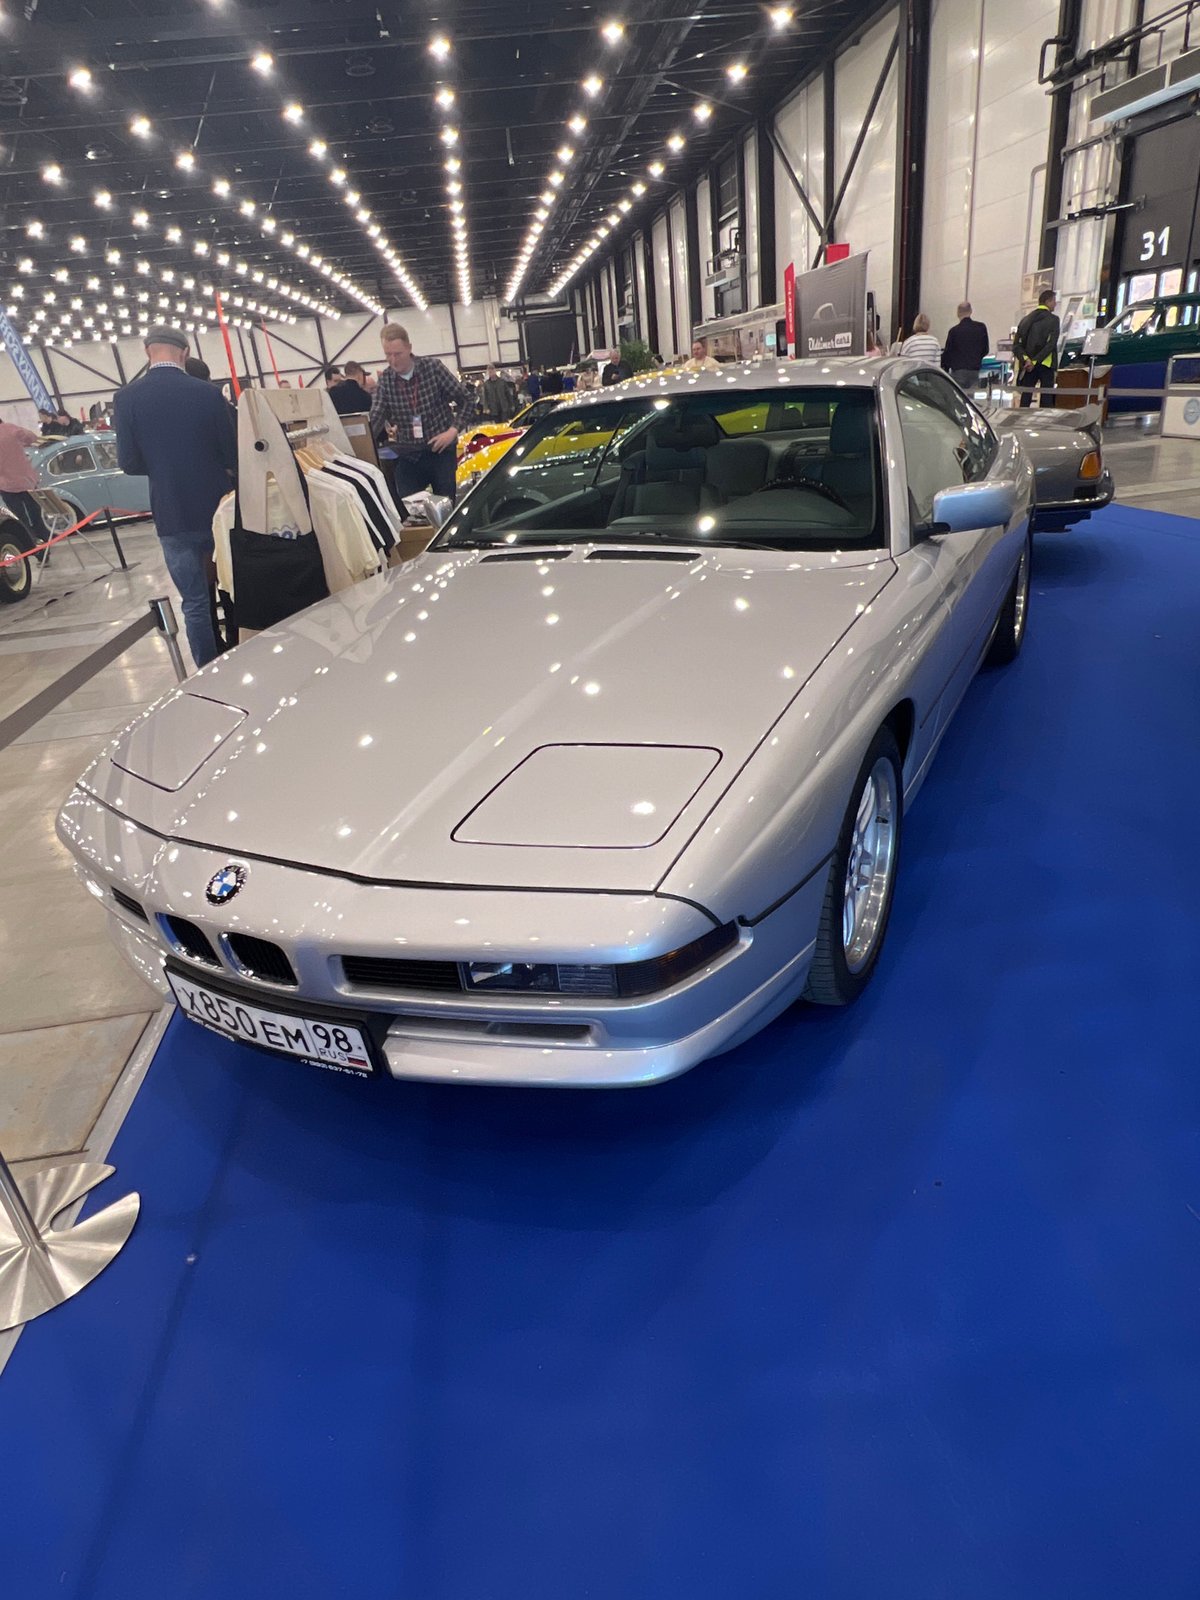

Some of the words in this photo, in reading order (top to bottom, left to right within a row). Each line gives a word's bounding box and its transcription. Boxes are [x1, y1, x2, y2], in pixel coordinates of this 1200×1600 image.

[1140, 226, 1170, 261] 31
[312, 1024, 353, 1053] 98
[319, 1048, 347, 1061] RUS
